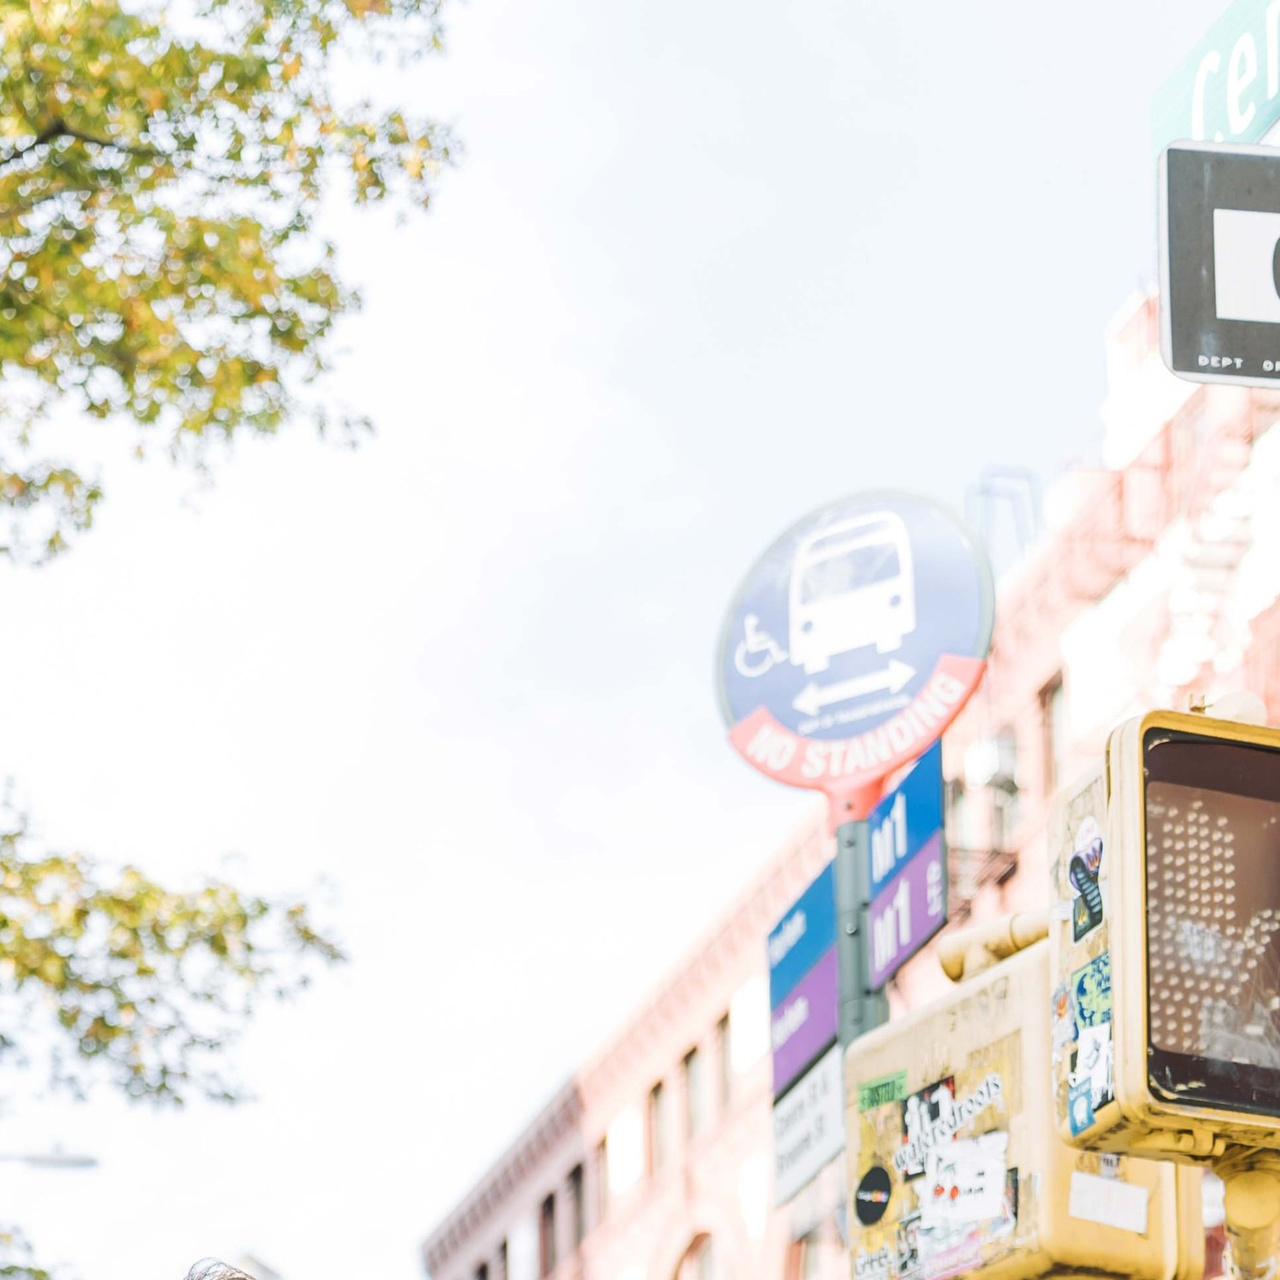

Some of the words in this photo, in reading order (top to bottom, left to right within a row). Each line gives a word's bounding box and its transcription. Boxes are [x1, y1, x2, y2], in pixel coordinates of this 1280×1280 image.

[1198, 355, 1243, 369] DEPT
[747, 722, 797, 771] NO
[800, 674, 966, 778] STANDING
[872, 792, 907, 883] M1
[874, 878, 911, 972] M1
